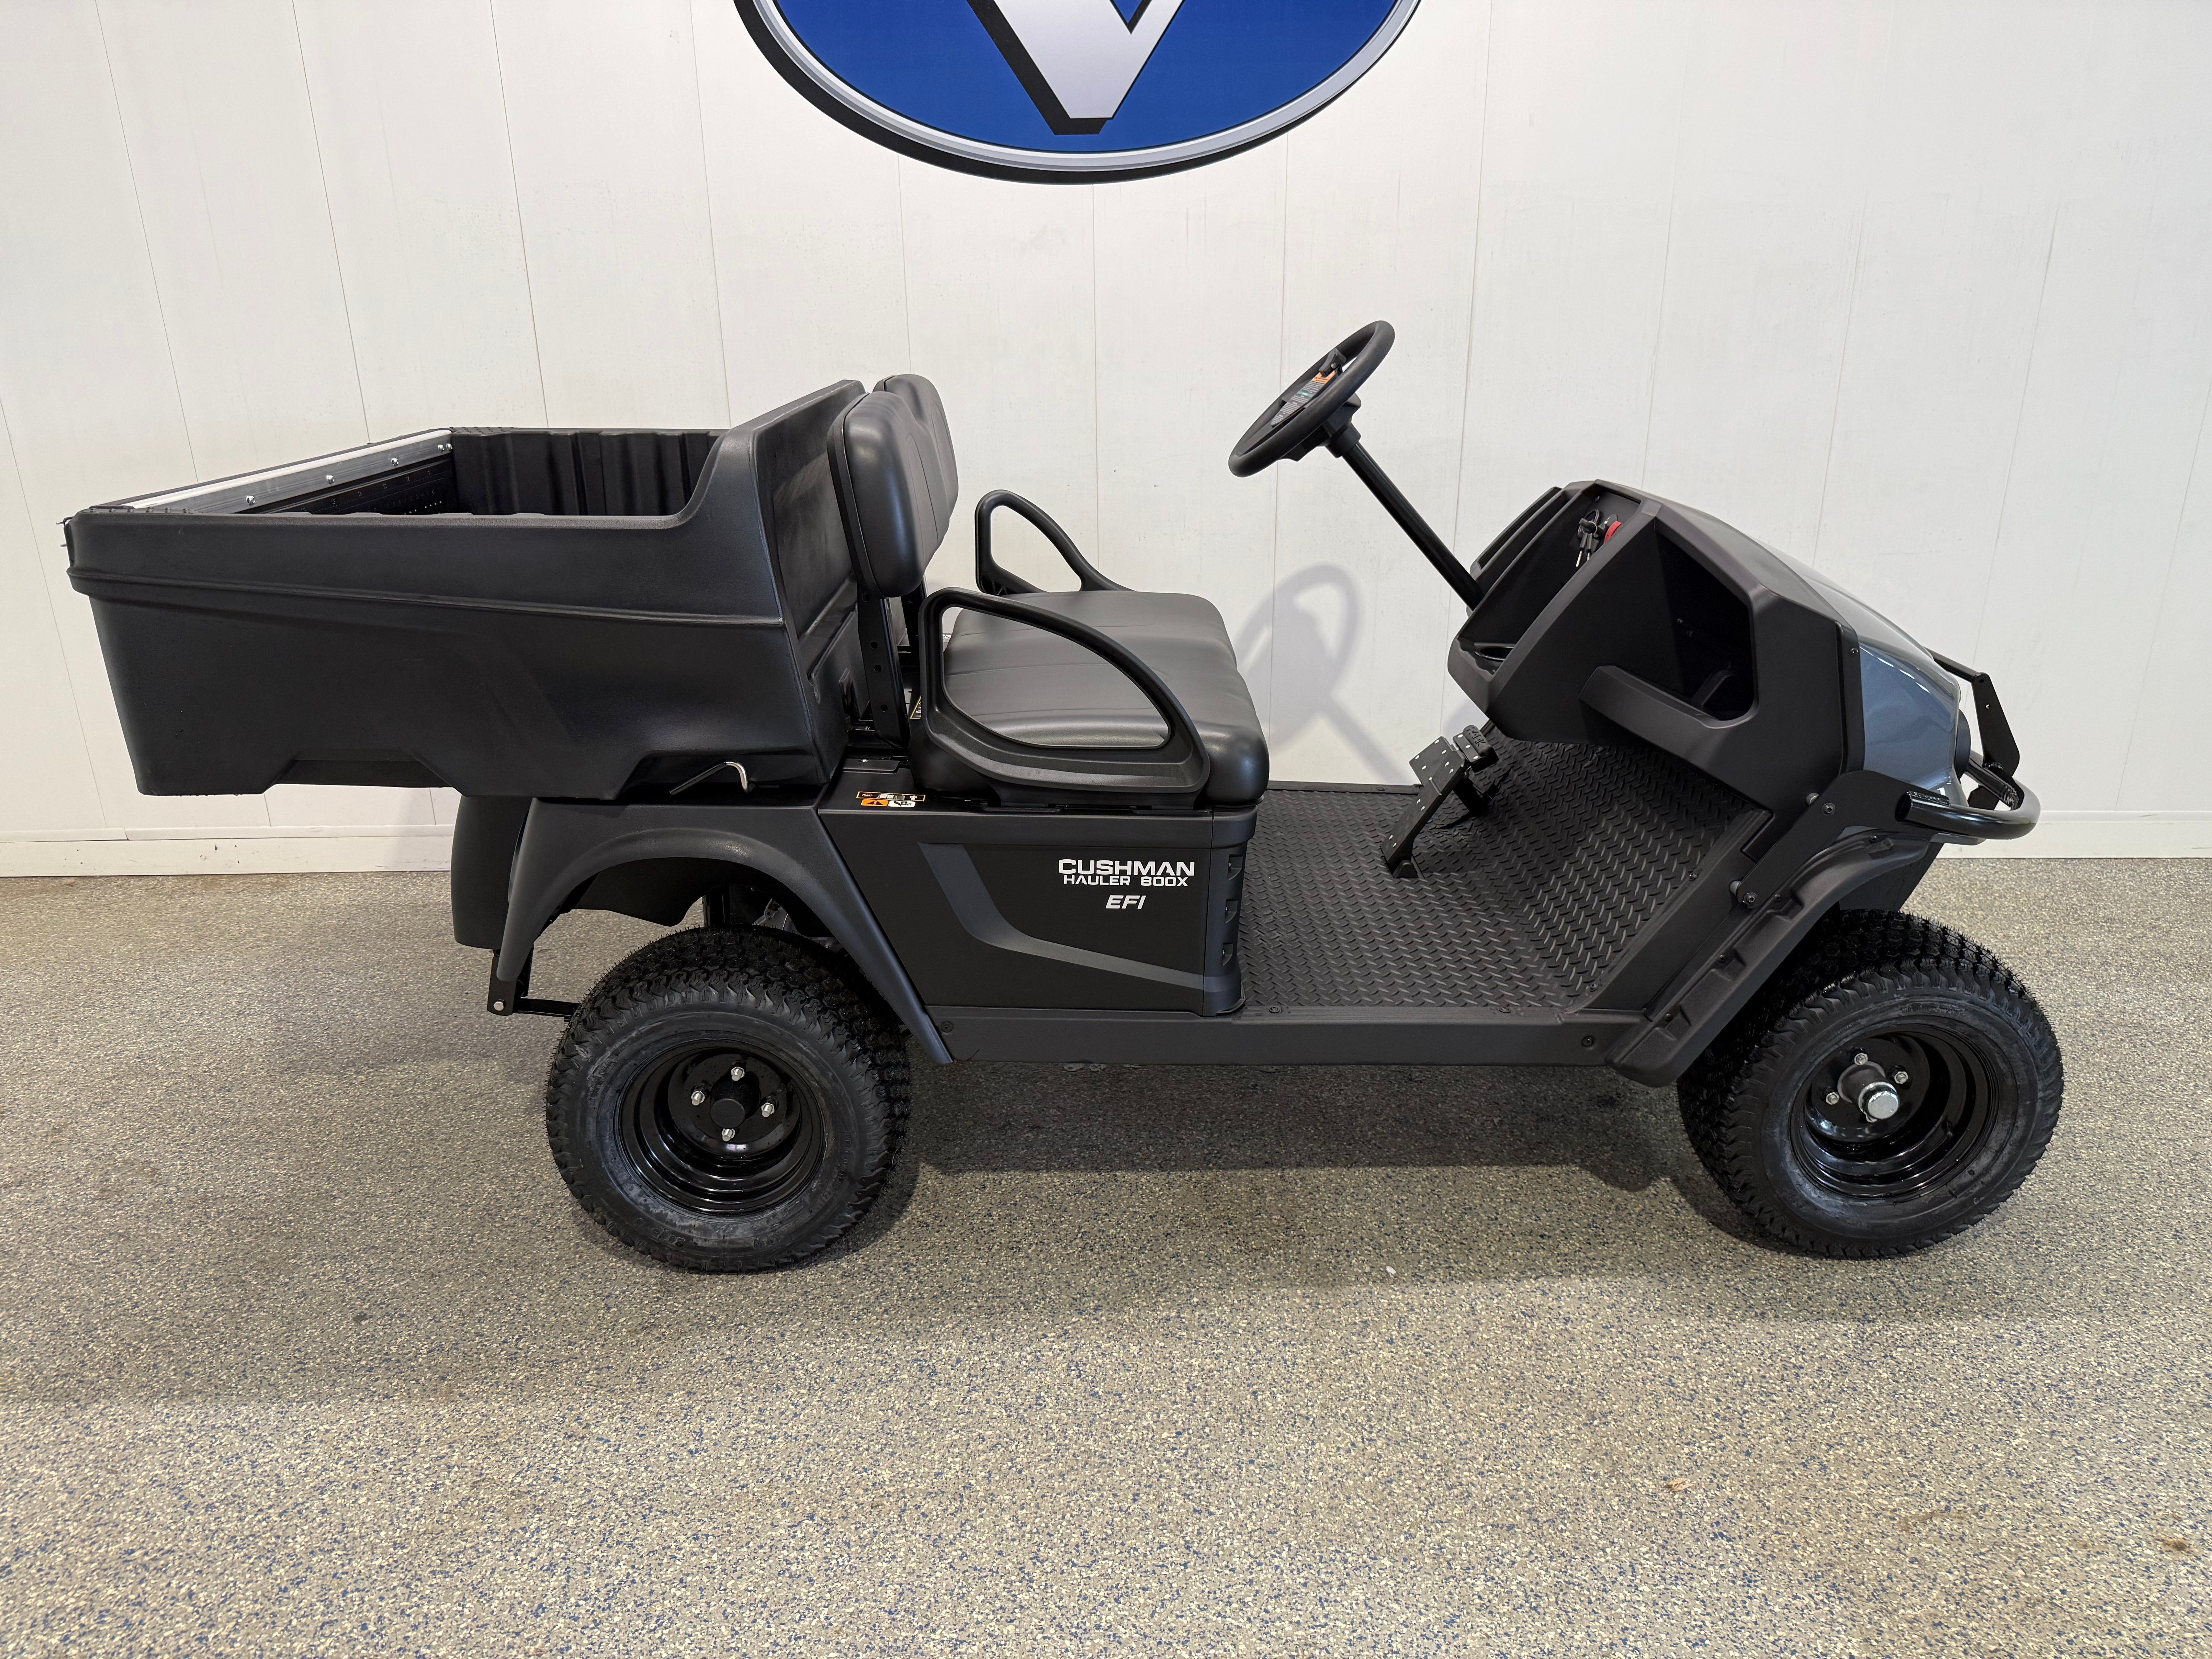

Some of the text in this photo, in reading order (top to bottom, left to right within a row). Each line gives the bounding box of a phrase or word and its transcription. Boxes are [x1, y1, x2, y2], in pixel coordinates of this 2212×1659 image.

[1466, 727, 1486, 747] PARK
[1058, 859, 1195, 876] CUSHMAN
[1063, 874, 1188, 887] HAULER 800X
[1105, 895, 1146, 909] EFI
